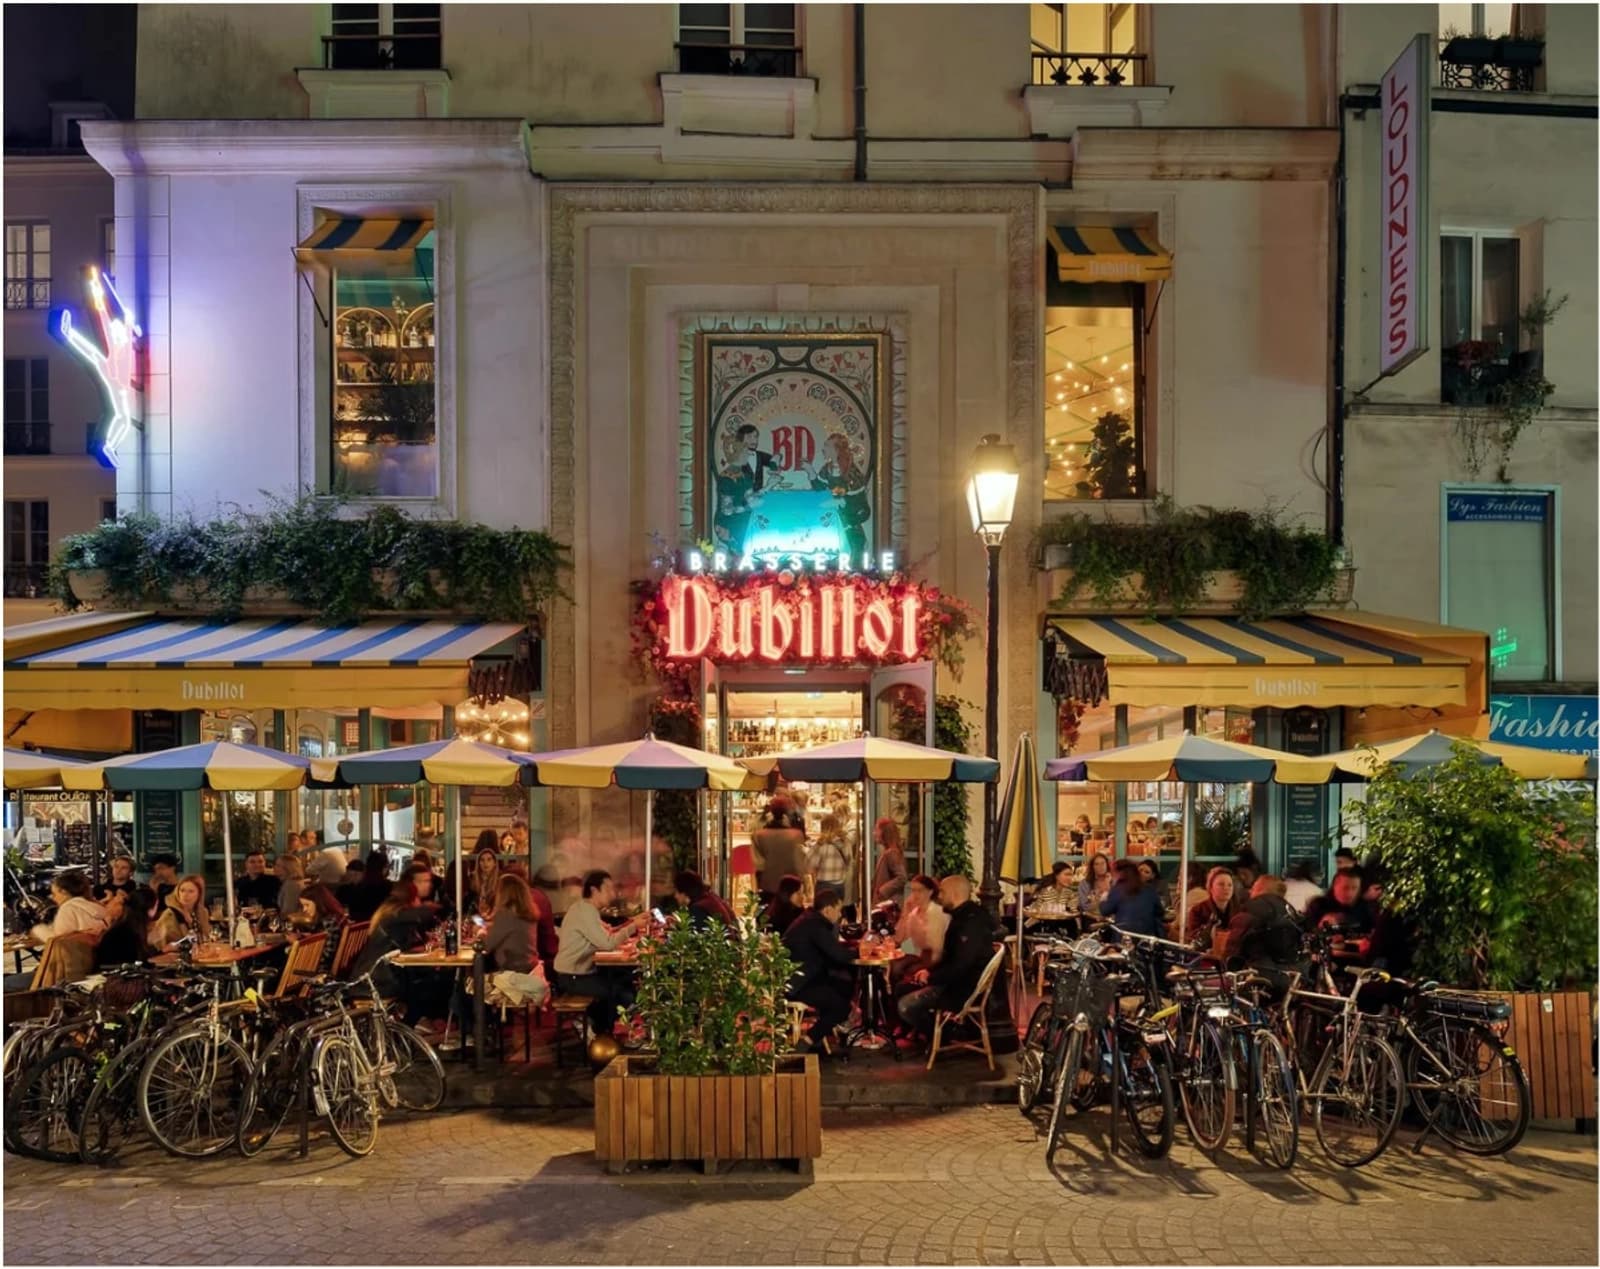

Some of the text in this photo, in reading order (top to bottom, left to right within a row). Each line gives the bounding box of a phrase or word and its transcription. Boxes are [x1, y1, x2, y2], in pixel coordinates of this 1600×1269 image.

[1388, 74, 1409, 354] LOUDNESS
[1481, 498, 1541, 513] Fashion
[690, 552, 895, 571] BRASSERIE
[666, 580, 921, 660] Dubillot
[182, 680, 245, 700] Dubillot
[9, 791, 58, 801] Rstaurant
